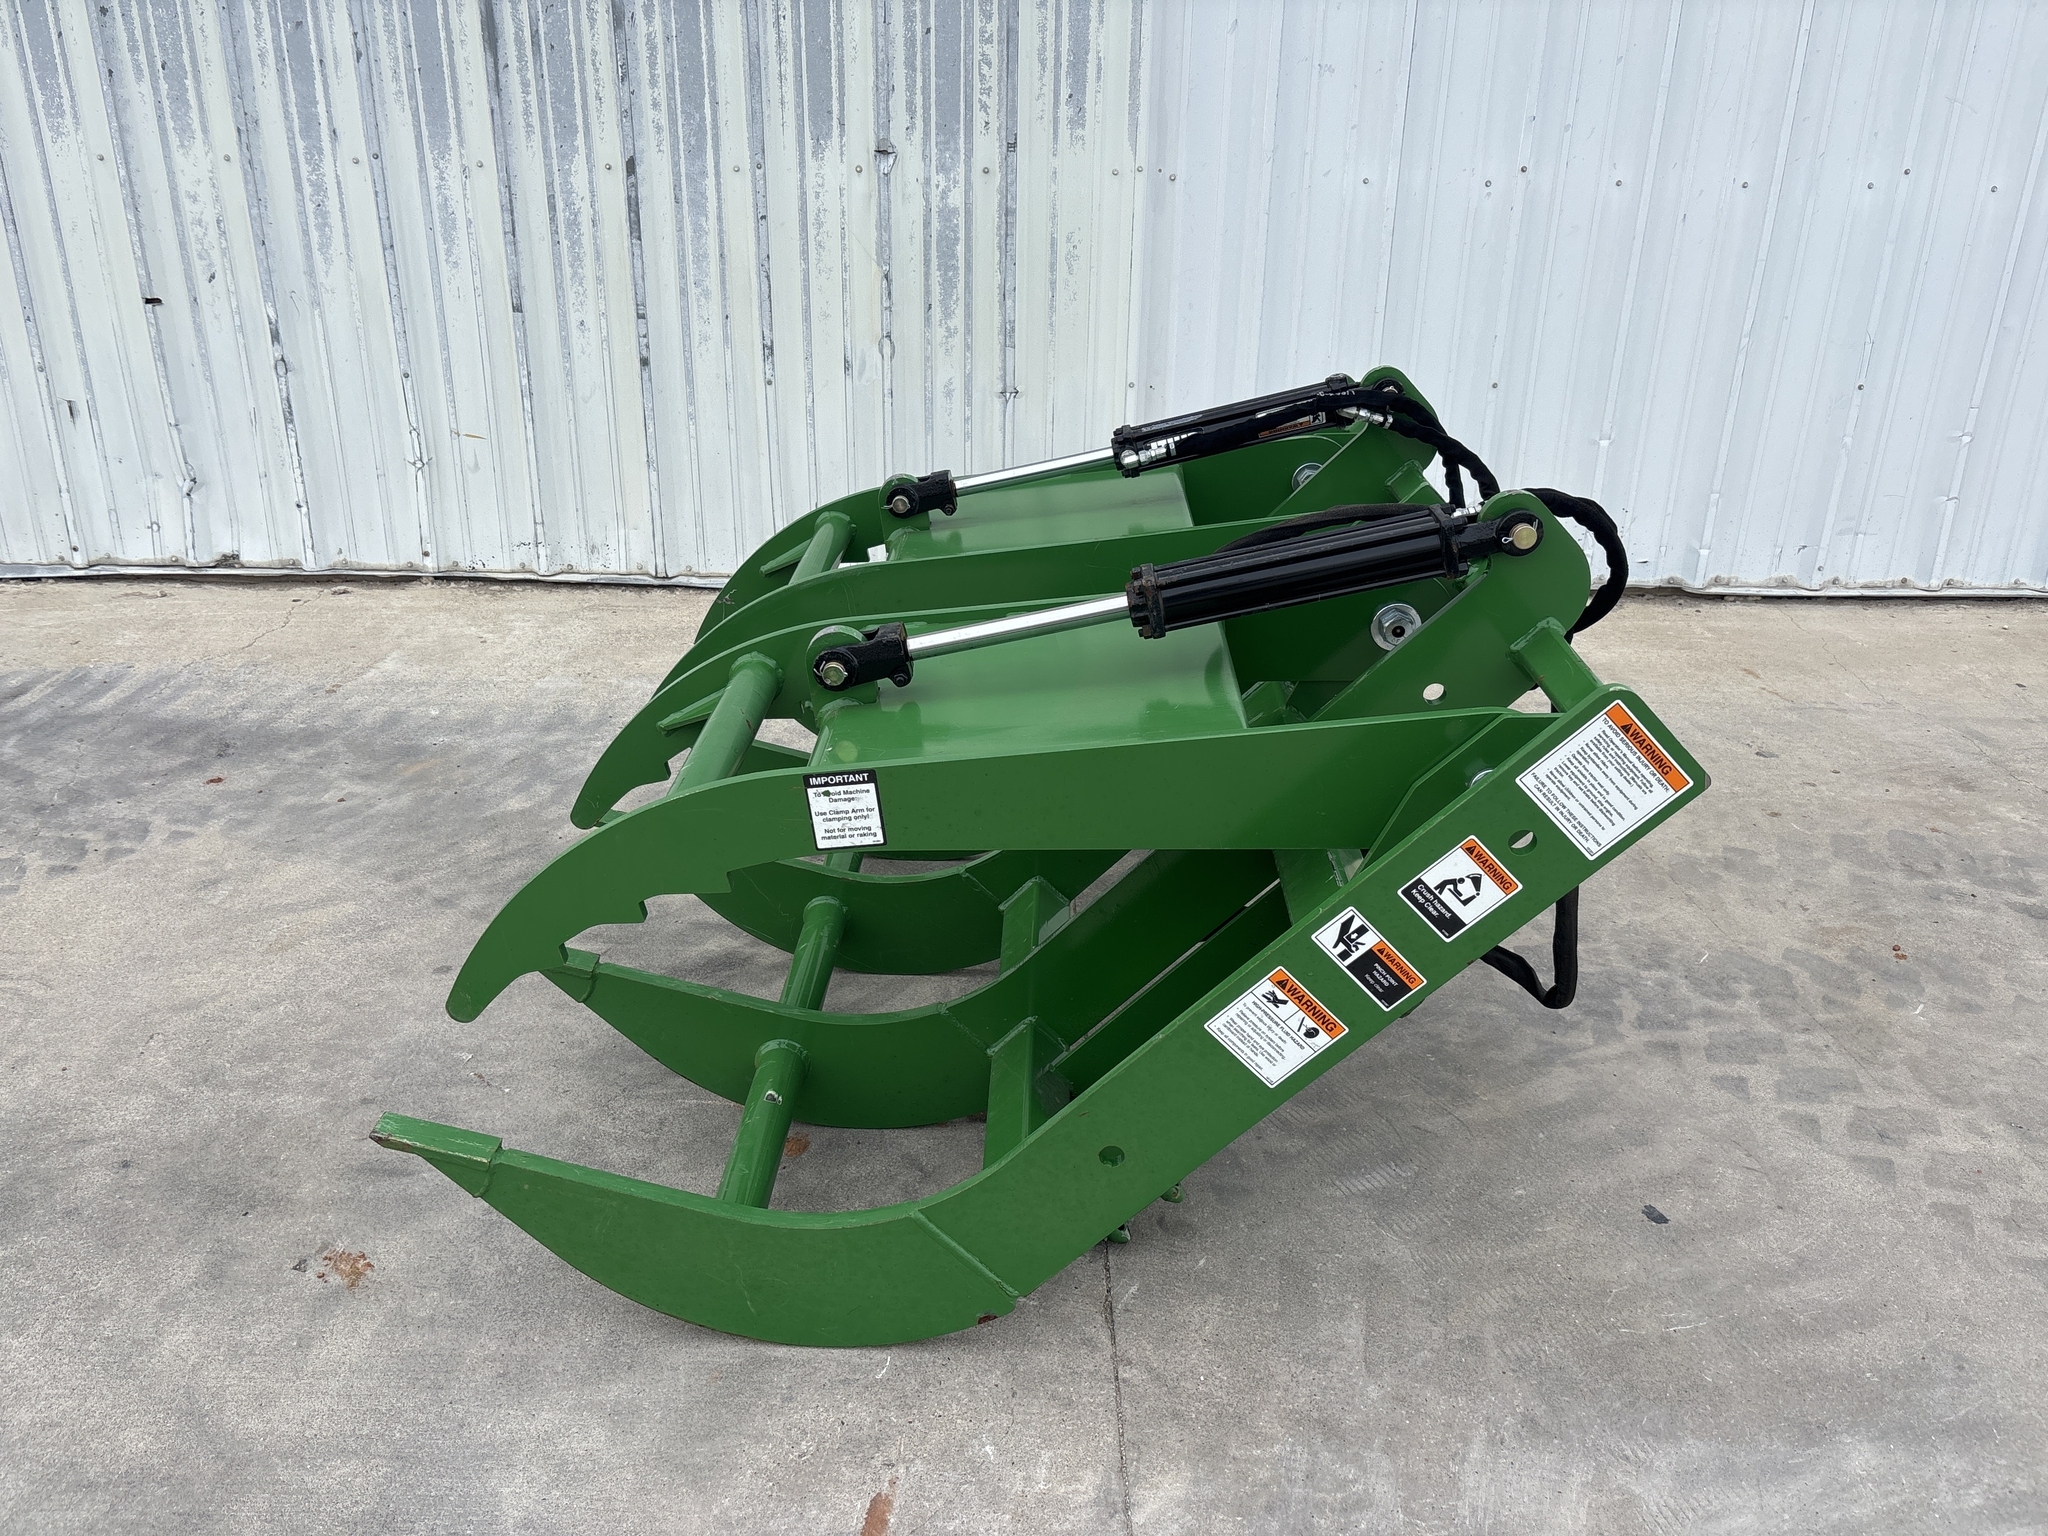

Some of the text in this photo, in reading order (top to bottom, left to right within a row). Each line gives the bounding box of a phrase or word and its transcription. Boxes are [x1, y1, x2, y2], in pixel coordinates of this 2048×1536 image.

[1601, 717, 1609, 725] TO
[1606, 723, 1621, 738] AVOID
[1618, 736, 1638, 756] SERIOUS
[1635, 754, 1651, 771] INJURY
[1648, 769, 1657, 778] OR
[1627, 728, 1673, 776] WARNING
[810, 773, 868, 785] IMPORTANT
[1530, 772, 1547, 788] FAILURE
[1550, 792, 1567, 810] FOLLOW
[1564, 808, 1578, 821] THESE
[1575, 820, 1602, 847] INSTRUCTIONS
[1533, 783, 1543, 793] CAN
[1540, 791, 1556, 807] RESULT
[1558, 810, 1572, 824] INJURY
[1472, 850, 1513, 890] WARNING
[1409, 888, 1441, 918] Keep Clear.
[1416, 883, 1453, 919] Crush hazard.
[1371, 970, 1389, 986] HAZARD
[1373, 962, 1387, 975] PINCH
[1384, 974, 1398, 987] POINT
[1382, 951, 1417, 984] WARNING
[1251, 1000, 1281, 1027] HIGH-PRESSURE
[1278, 1025, 1291, 1037] FLUID
[1288, 1035, 1305, 1050] HAZARD
[1284, 983, 1338, 1032] WARNING
